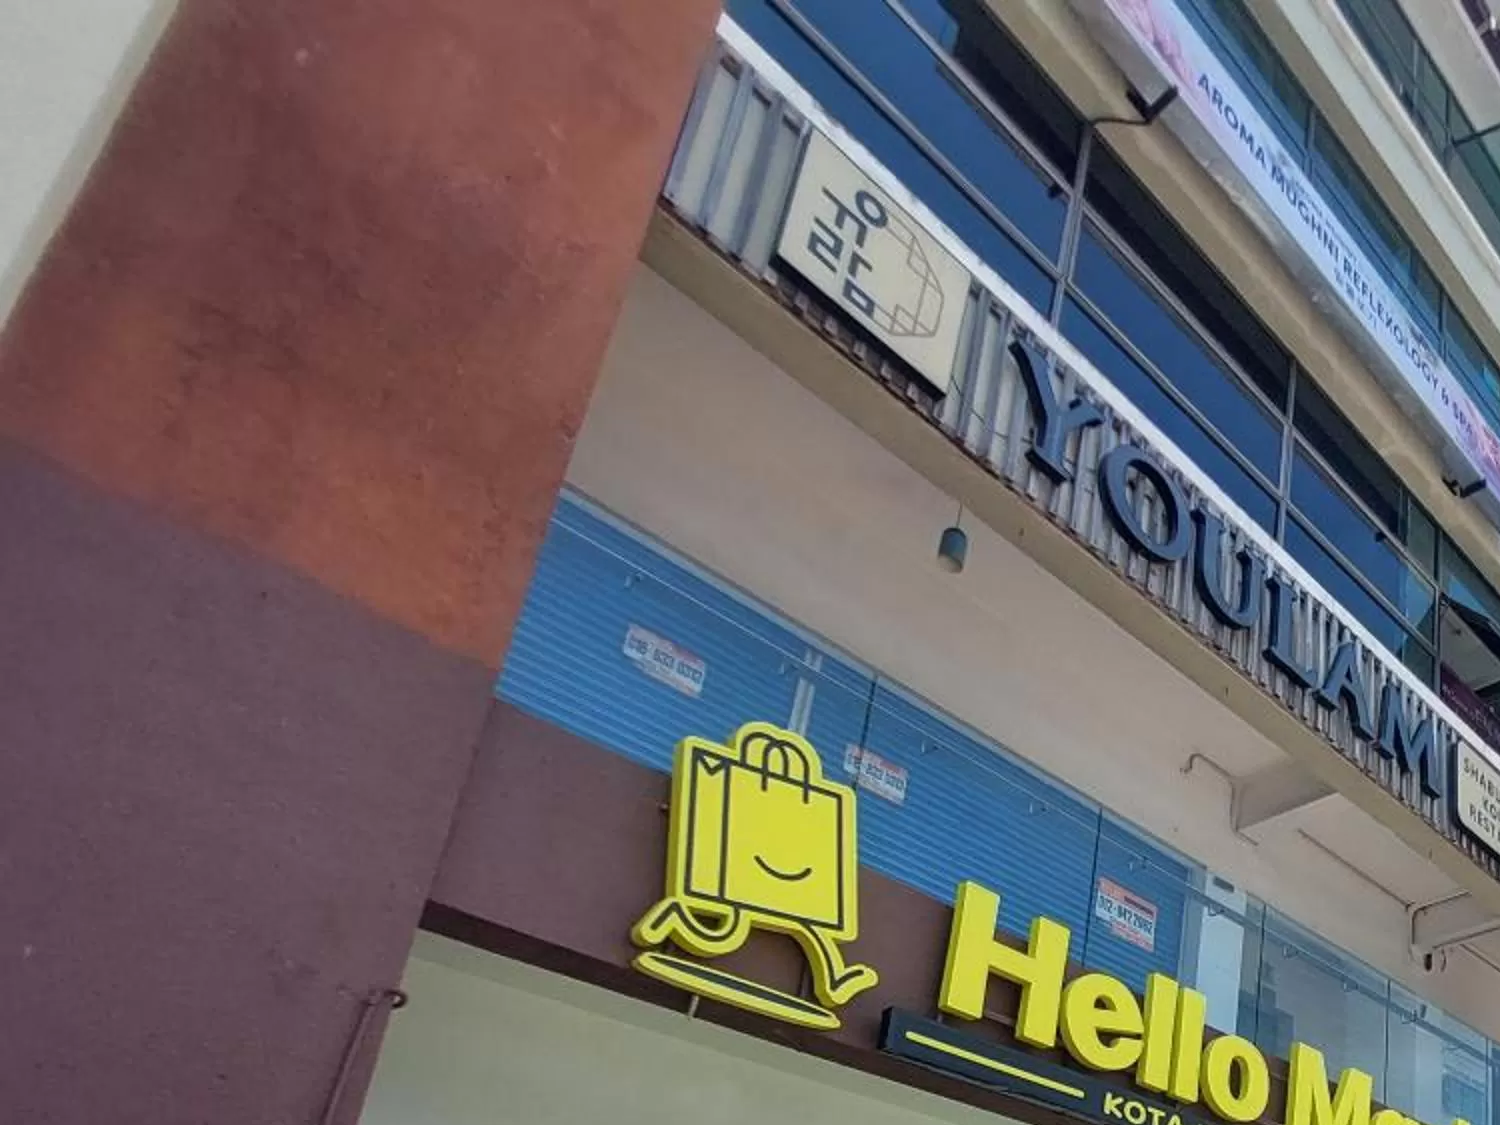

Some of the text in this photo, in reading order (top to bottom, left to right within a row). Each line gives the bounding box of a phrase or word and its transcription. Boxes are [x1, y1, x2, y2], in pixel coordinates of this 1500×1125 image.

[1197, 72, 1267, 169] AROMA
[1343, 260, 1440, 394] REFLEXOLOGY
[1008, 340, 1441, 801] YOULAM
[938, 880, 1271, 1124] Hello
